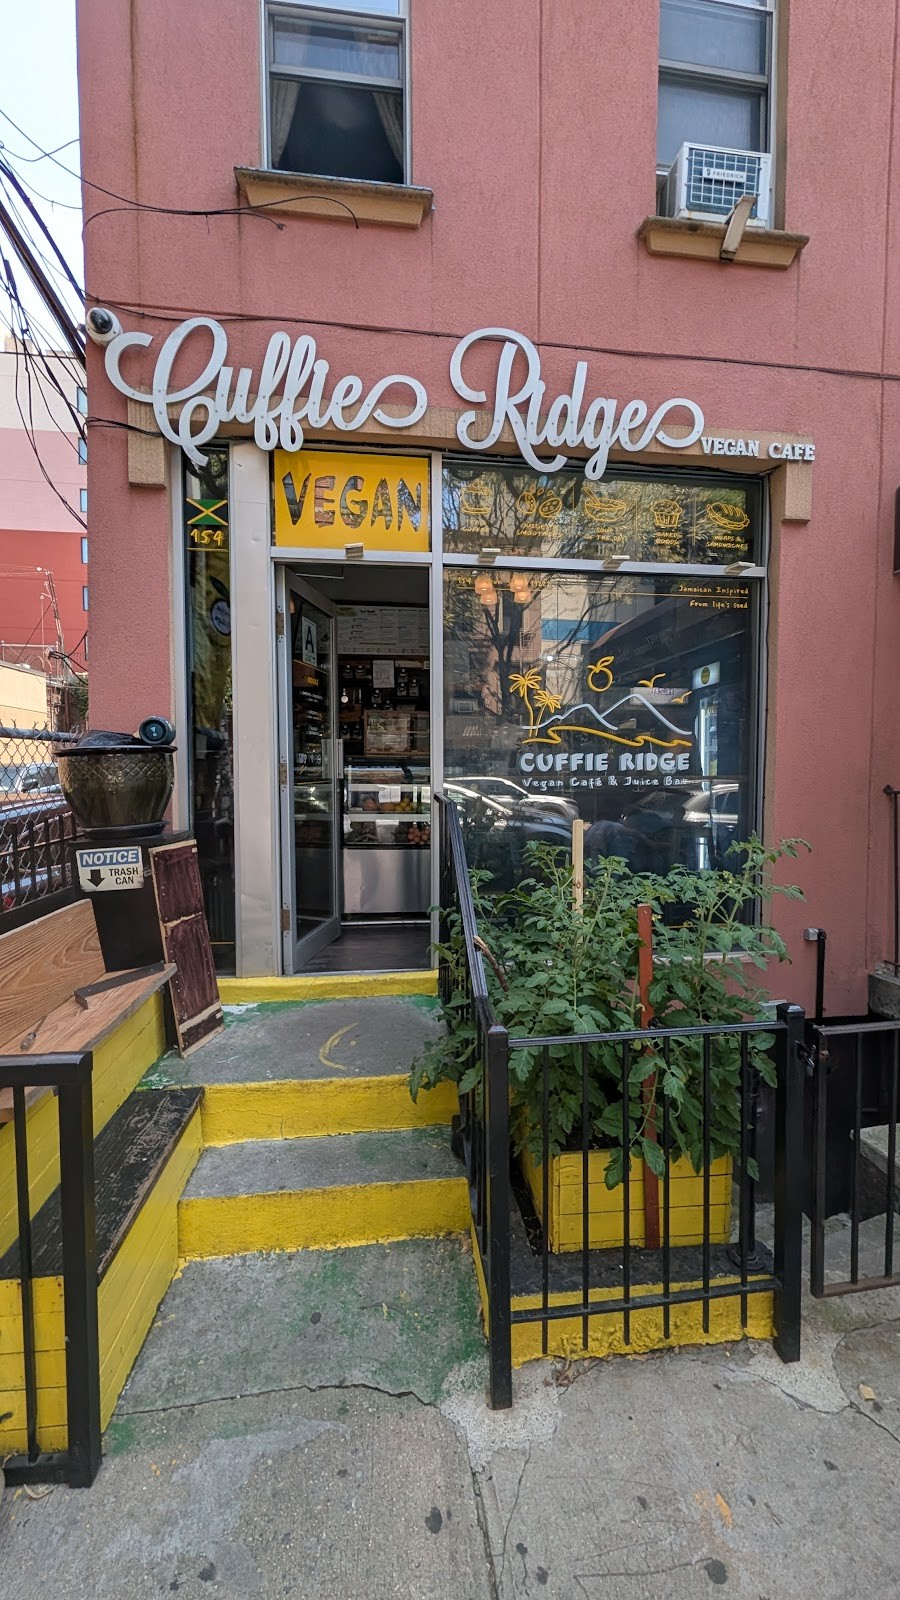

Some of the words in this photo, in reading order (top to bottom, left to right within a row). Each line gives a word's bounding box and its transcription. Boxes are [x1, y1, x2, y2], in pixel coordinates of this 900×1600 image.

[712, 170, 744, 179] FRIEDRICH
[105, 317, 428, 467] Cuffie
[450, 327, 704, 480] Ridge
[701, 437, 760, 457] VEGAN
[768, 442, 815, 460] CAFE
[281, 472, 423, 532] VEGAN
[190, 529, 225, 546] 154
[679, 585, 712, 593] Jamaican
[716, 587, 749, 596] Inspired
[305, 625, 315, 653] A
[520, 752, 609, 772] CUFFIE
[619, 752, 690, 773] RIDGE
[522, 777, 564, 791] Vegan
[570, 776, 603, 789] Café
[608, 775, 618, 786] &
[623, 776, 660, 787] Juice
[664, 776, 688, 786] Bar
[82, 850, 138, 866] NOTICE
[108, 866, 139, 876] TRASH
[115, 876, 134, 885] CAN
